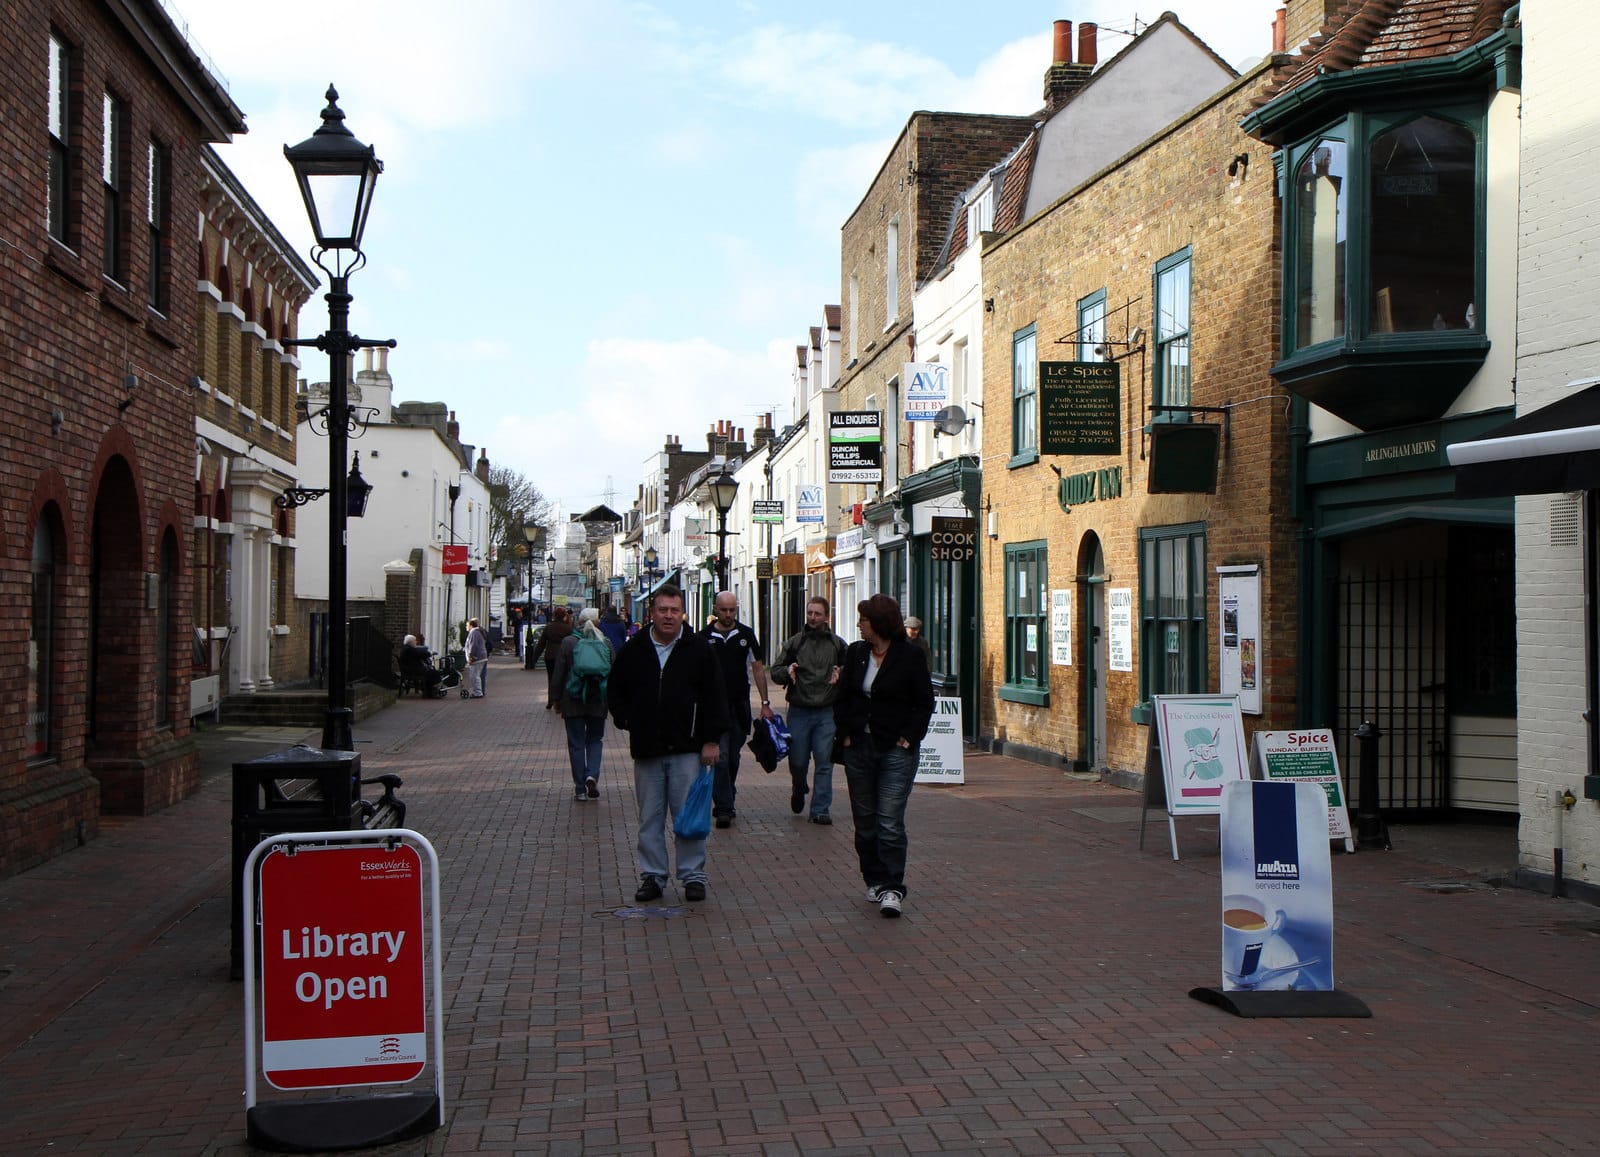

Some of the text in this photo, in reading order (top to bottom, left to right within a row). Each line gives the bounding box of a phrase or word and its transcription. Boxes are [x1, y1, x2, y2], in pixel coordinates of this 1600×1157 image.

[1073, 366, 1112, 378] Spice
[908, 372, 945, 391] AM
[908, 402, 944, 410] LET BY
[832, 414, 878, 424] ALL ENQUIRIES
[1364, 440, 1436, 462] ARLINGHAM MEWS
[1058, 466, 1122, 514] QUIDZ INN
[798, 491, 820, 503] AM
[932, 532, 974, 544] COOK
[932, 548, 974, 560] SHOP
[940, 700, 958, 714] INN
[1288, 732, 1328, 746] Spice
[1256, 860, 1298, 872] LAVAZZA
[1256, 882, 1300, 890] served here
[282, 926, 406, 962] Library
[296, 972, 388, 1009] Open
